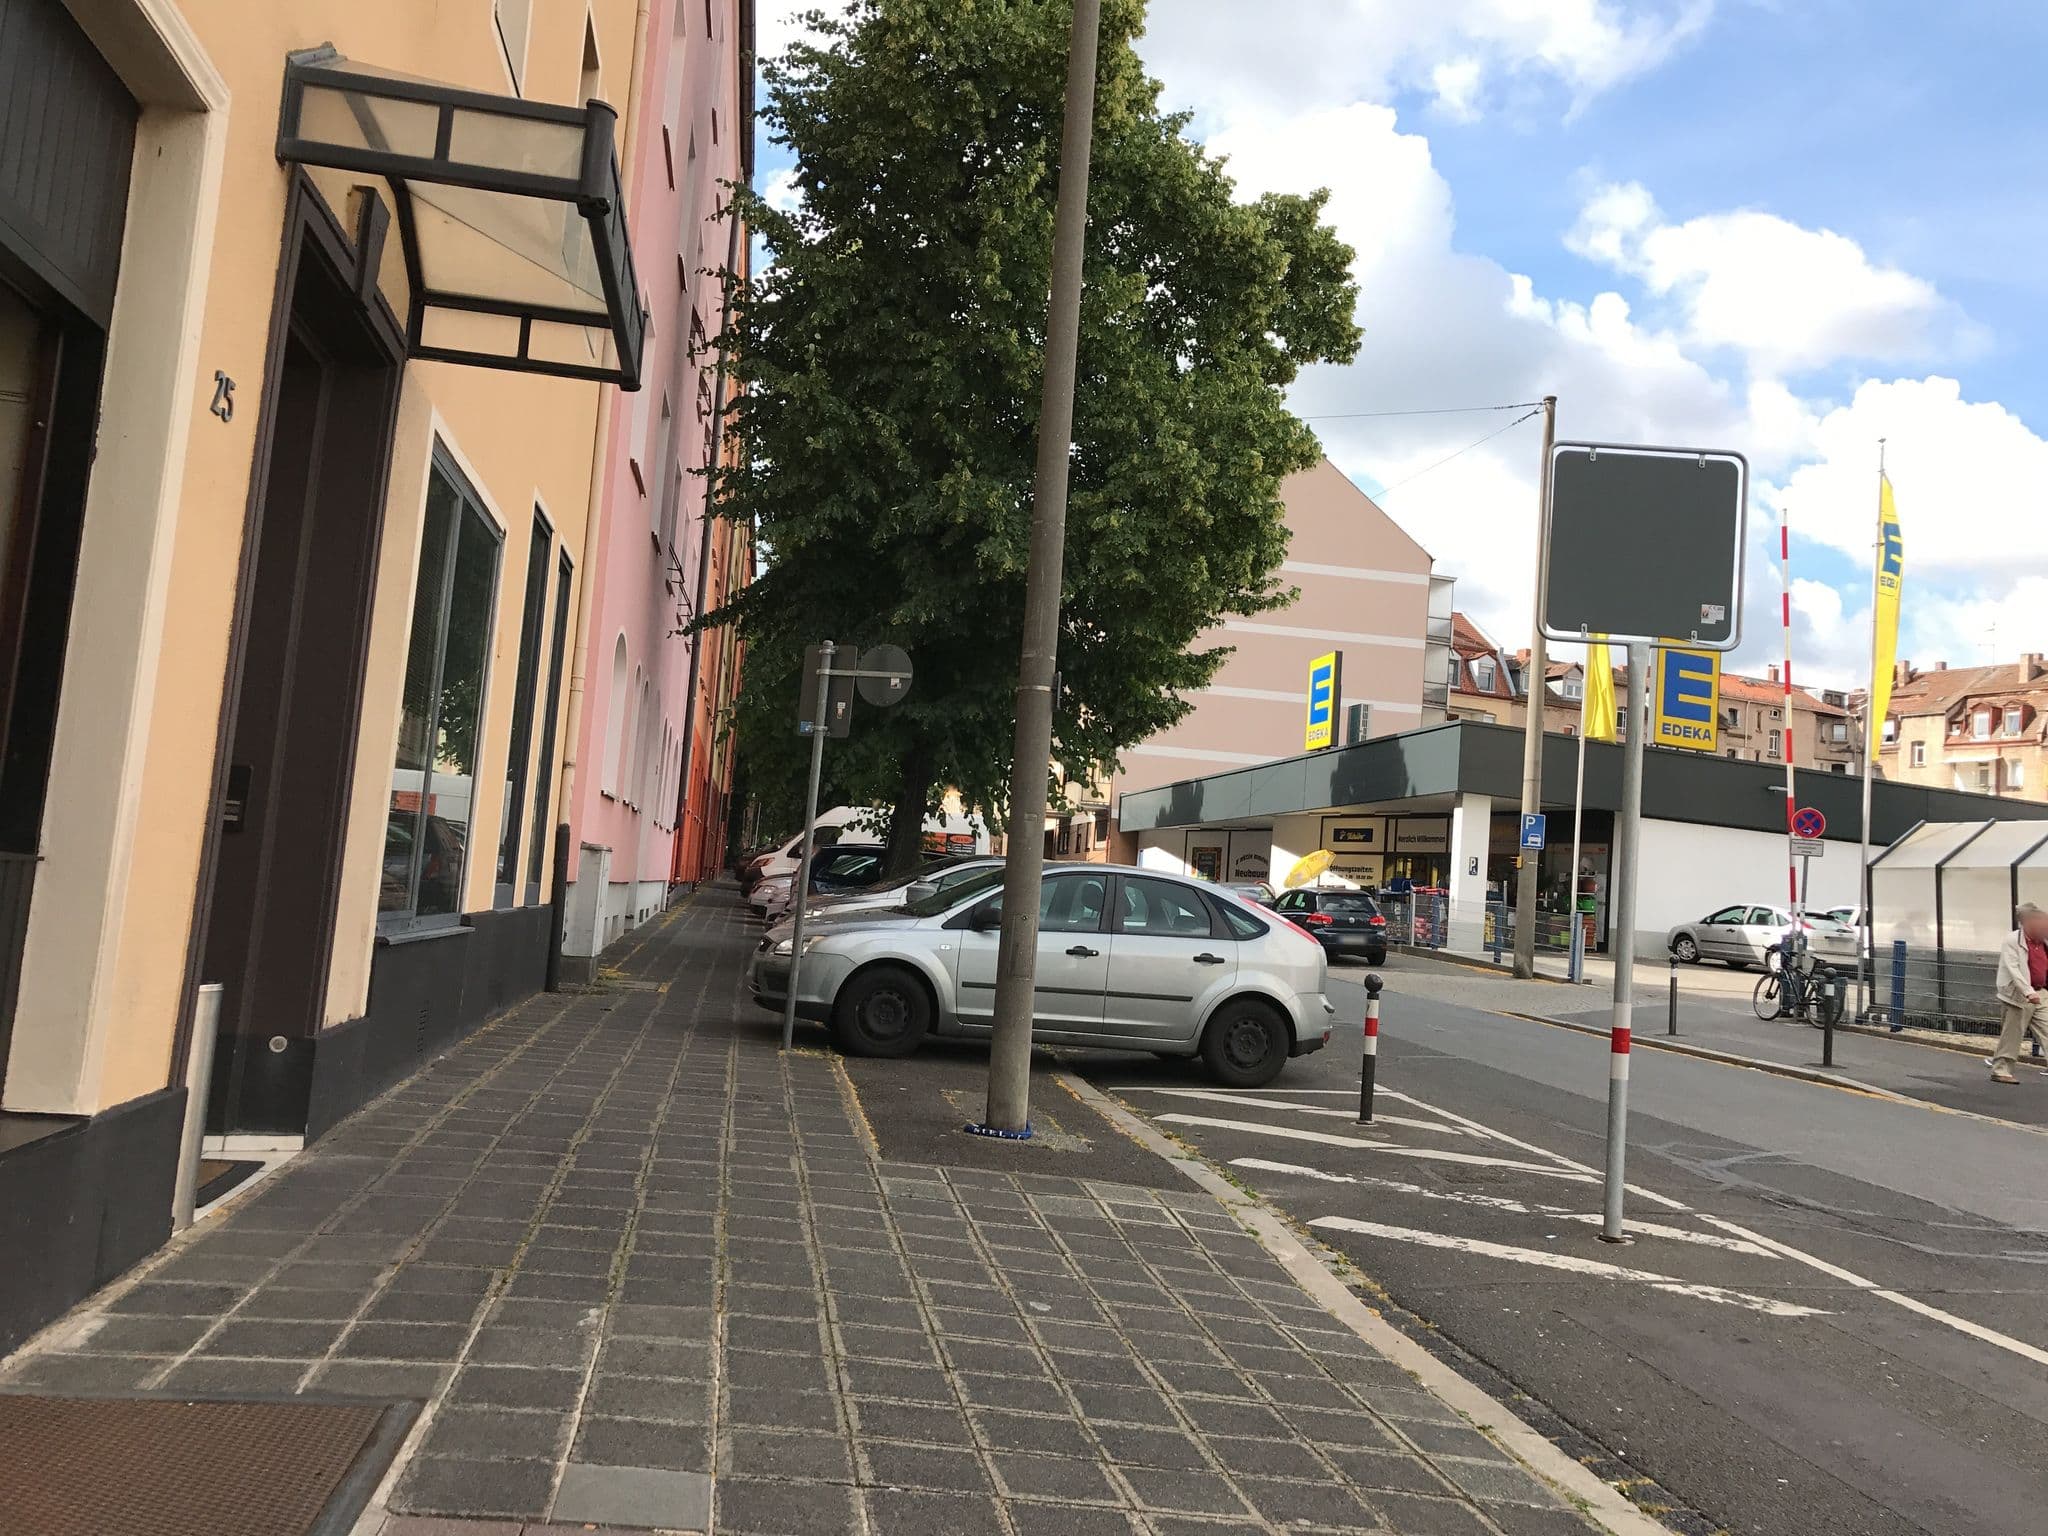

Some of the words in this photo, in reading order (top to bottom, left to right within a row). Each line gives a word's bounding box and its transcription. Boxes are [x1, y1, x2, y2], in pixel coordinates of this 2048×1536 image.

[210, 370, 236, 423] 25
[1309, 664, 1332, 726] E
[1662, 650, 1714, 723] E
[1661, 722, 1712, 742] EDEKA
[1525, 815, 1536, 830] P
